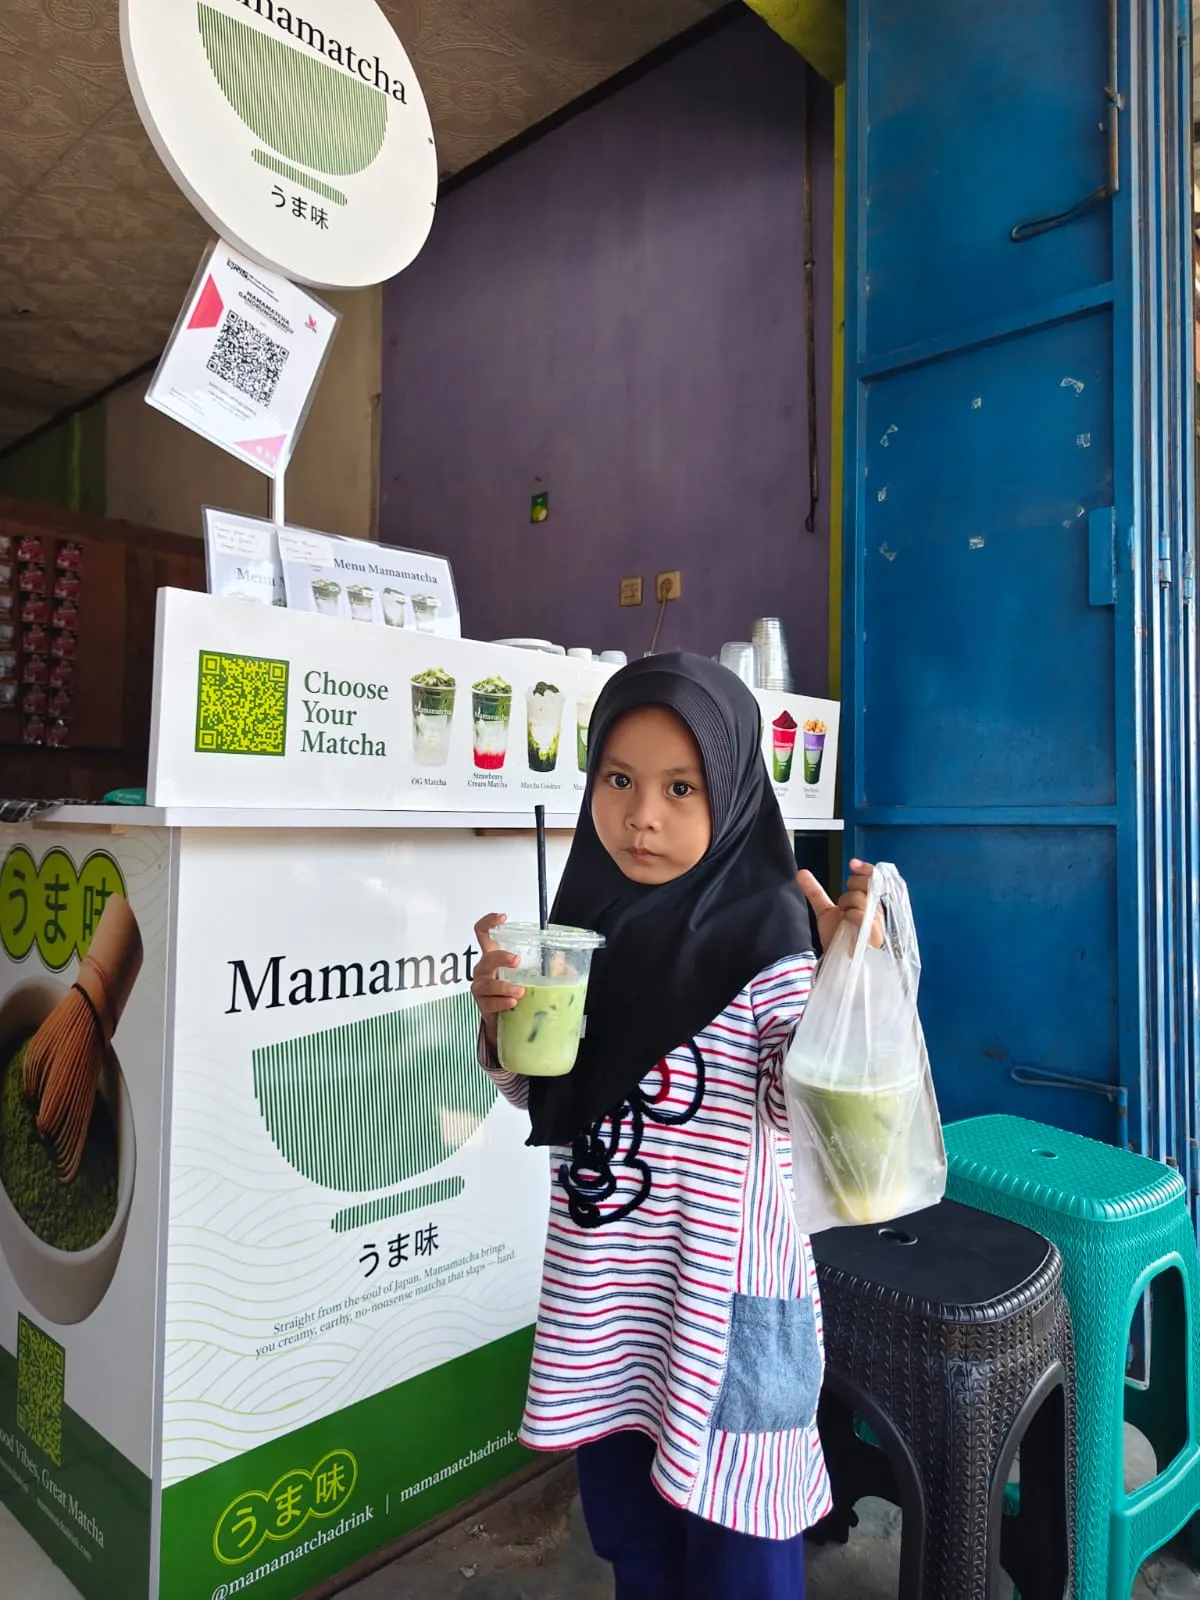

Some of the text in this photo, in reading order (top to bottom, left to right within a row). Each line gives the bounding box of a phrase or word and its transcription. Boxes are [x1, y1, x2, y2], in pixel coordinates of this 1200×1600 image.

[237, 0, 407, 104] mamatcha
[271, 184, 329, 230] うま味
[236, 567, 276, 587] Menu
[333, 558, 366, 573] Menu
[368, 563, 438, 584] Mamamatcha
[304, 670, 389, 701] Choose
[301, 699, 357, 727] Your
[299, 729, 387, 757] Matcha
[411, 777, 447, 787] OG Matcha
[467, 779, 508, 789] Cream Matcha
[473, 772, 503, 781] Strawberry
[520, 781, 540, 790] Matcha
[224, 944, 479, 1015] Mamamat
[359, 1222, 440, 1278] うま味
[255, 1343, 276, 1360] you
[278, 1327, 318, 1349] creamy,
[320, 1313, 353, 1332] earthy,
[355, 1291, 414, 1319] no-nonsense
[415, 1277, 446, 1296] matcha
[447, 1271, 465, 1283] that
[466, 1262, 486, 1278] slaps
[497, 1250, 517, 1265] hard.
[273, 1243, 506, 1335] Straight from the soul of Japan, Mamamatcha brings
[0, 1428, 15, 1453] ood
[15, 1439, 40, 1484] Vibes,
[42, 1468, 67, 1508] Great
[68, 1493, 105, 1549] Matcha
[400, 1429, 521, 1502] mamamatchadrink.
[231, 1463, 346, 1548] うま味
[211, 1505, 375, 1600] @mamamatchadrink
